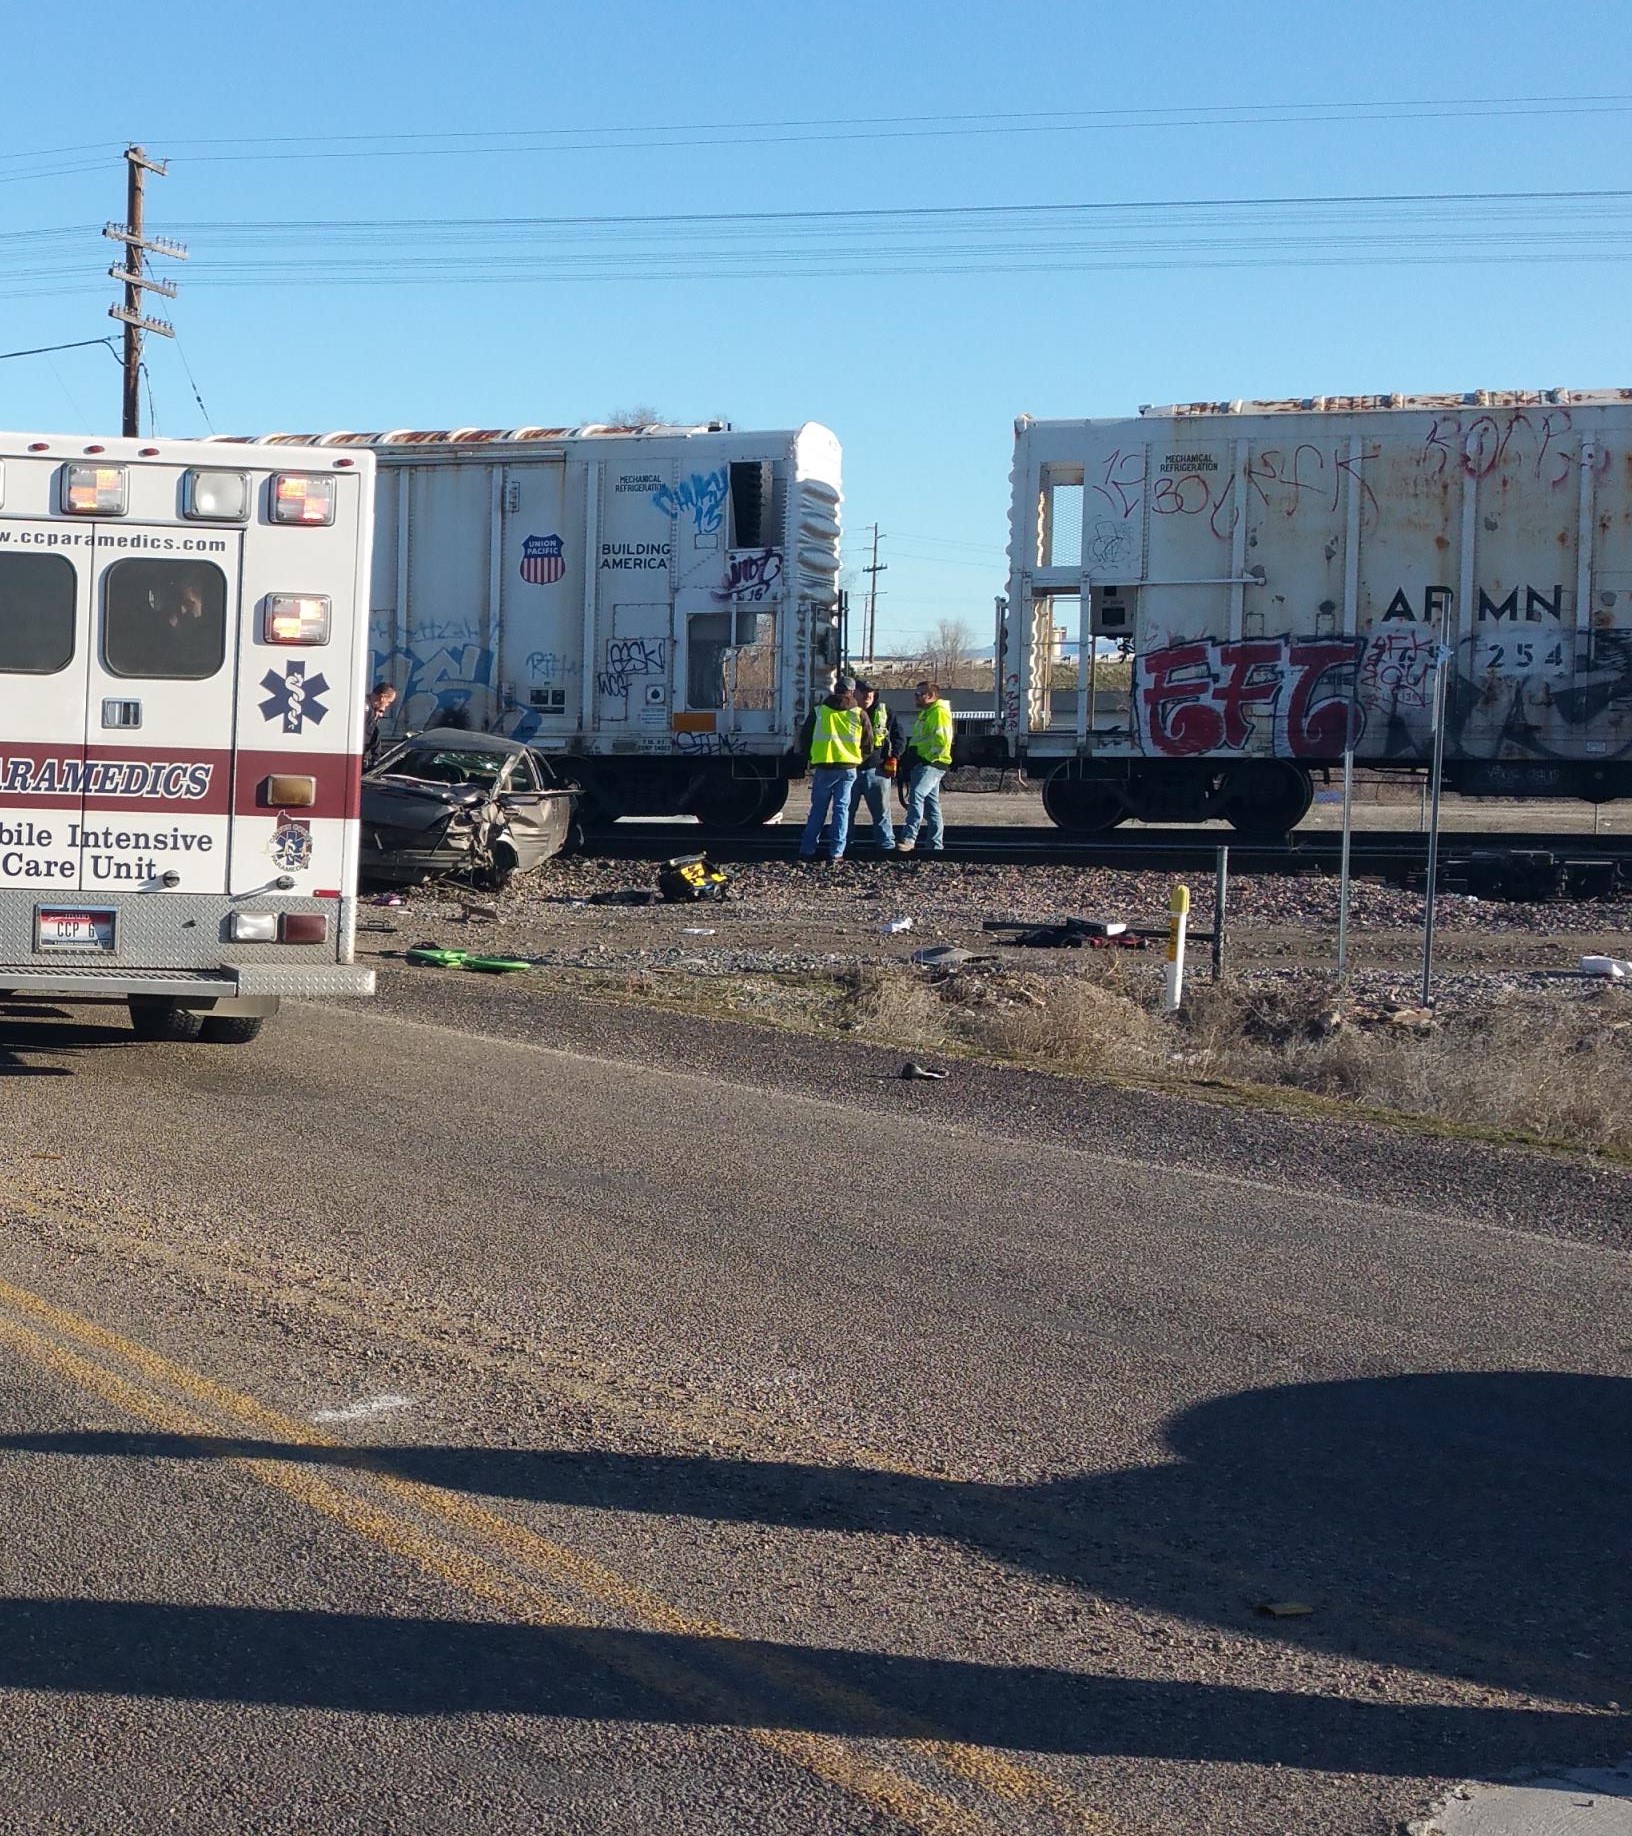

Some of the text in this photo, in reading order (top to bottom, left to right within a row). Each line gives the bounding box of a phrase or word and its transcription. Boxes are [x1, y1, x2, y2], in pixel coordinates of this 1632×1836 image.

[1165, 454, 1214, 463] MECHANICAL
[1159, 462, 1219, 472] REFRIGERATION
[619, 474, 663, 483] MECHANICAL
[615, 483, 666, 492] REFRIGERATION
[527, 547, 558, 555] PACIFIC
[602, 543, 671, 555] BUILDING
[600, 558, 668, 569] AMERICA
[1478, 585, 1562, 621] MN
[1486, 643, 1564, 669] 254
[68, 824, 213, 851] Intensive
[2, 852, 157, 880] Care Unit
[57, 921, 95, 938] CCP 6
